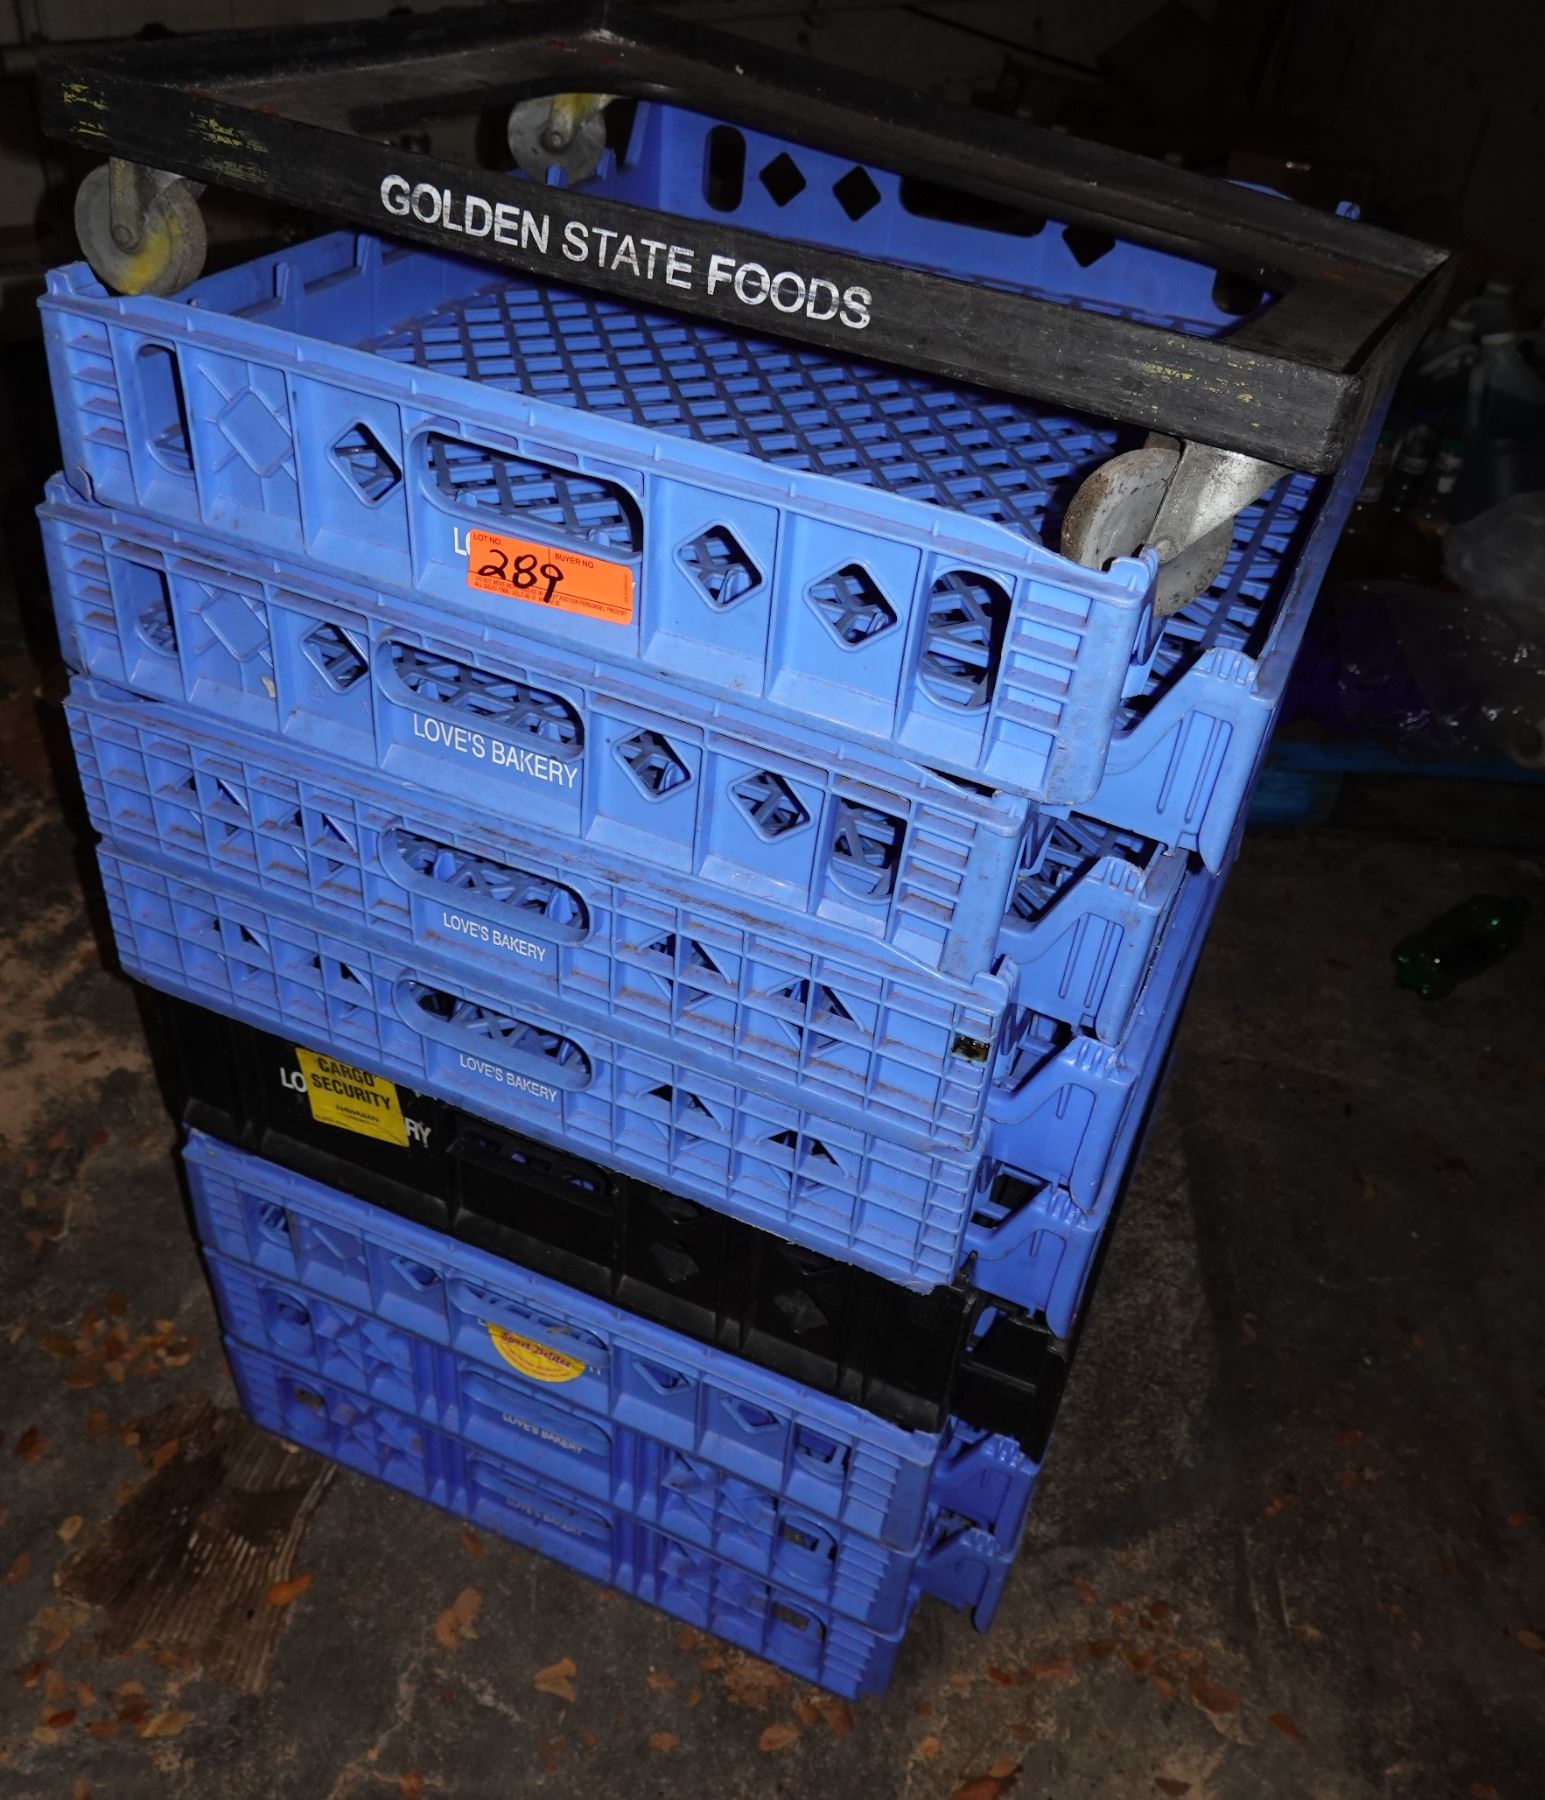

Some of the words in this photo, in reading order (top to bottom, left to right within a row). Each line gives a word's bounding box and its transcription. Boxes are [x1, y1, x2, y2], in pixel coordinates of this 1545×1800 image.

[381, 174, 550, 254] GOLDEN
[562, 221, 695, 290] STATE
[707, 253, 873, 329] FOODS
[473, 533, 487, 543] LOT
[554, 553, 581, 565] BUYER
[478, 549, 564, 603] 289
[413, 713, 485, 758] LOVE'S
[491, 740, 578, 788] BAKERY
[443, 912, 490, 942] LOVE'S
[492, 930, 546, 962] BAKERY
[311, 1073, 390, 1110] SECURITY
[317, 1057, 375, 1088] CARGO
[459, 1054, 503, 1082] LOVE'S
[506, 1072, 558, 1102] BAKERY
